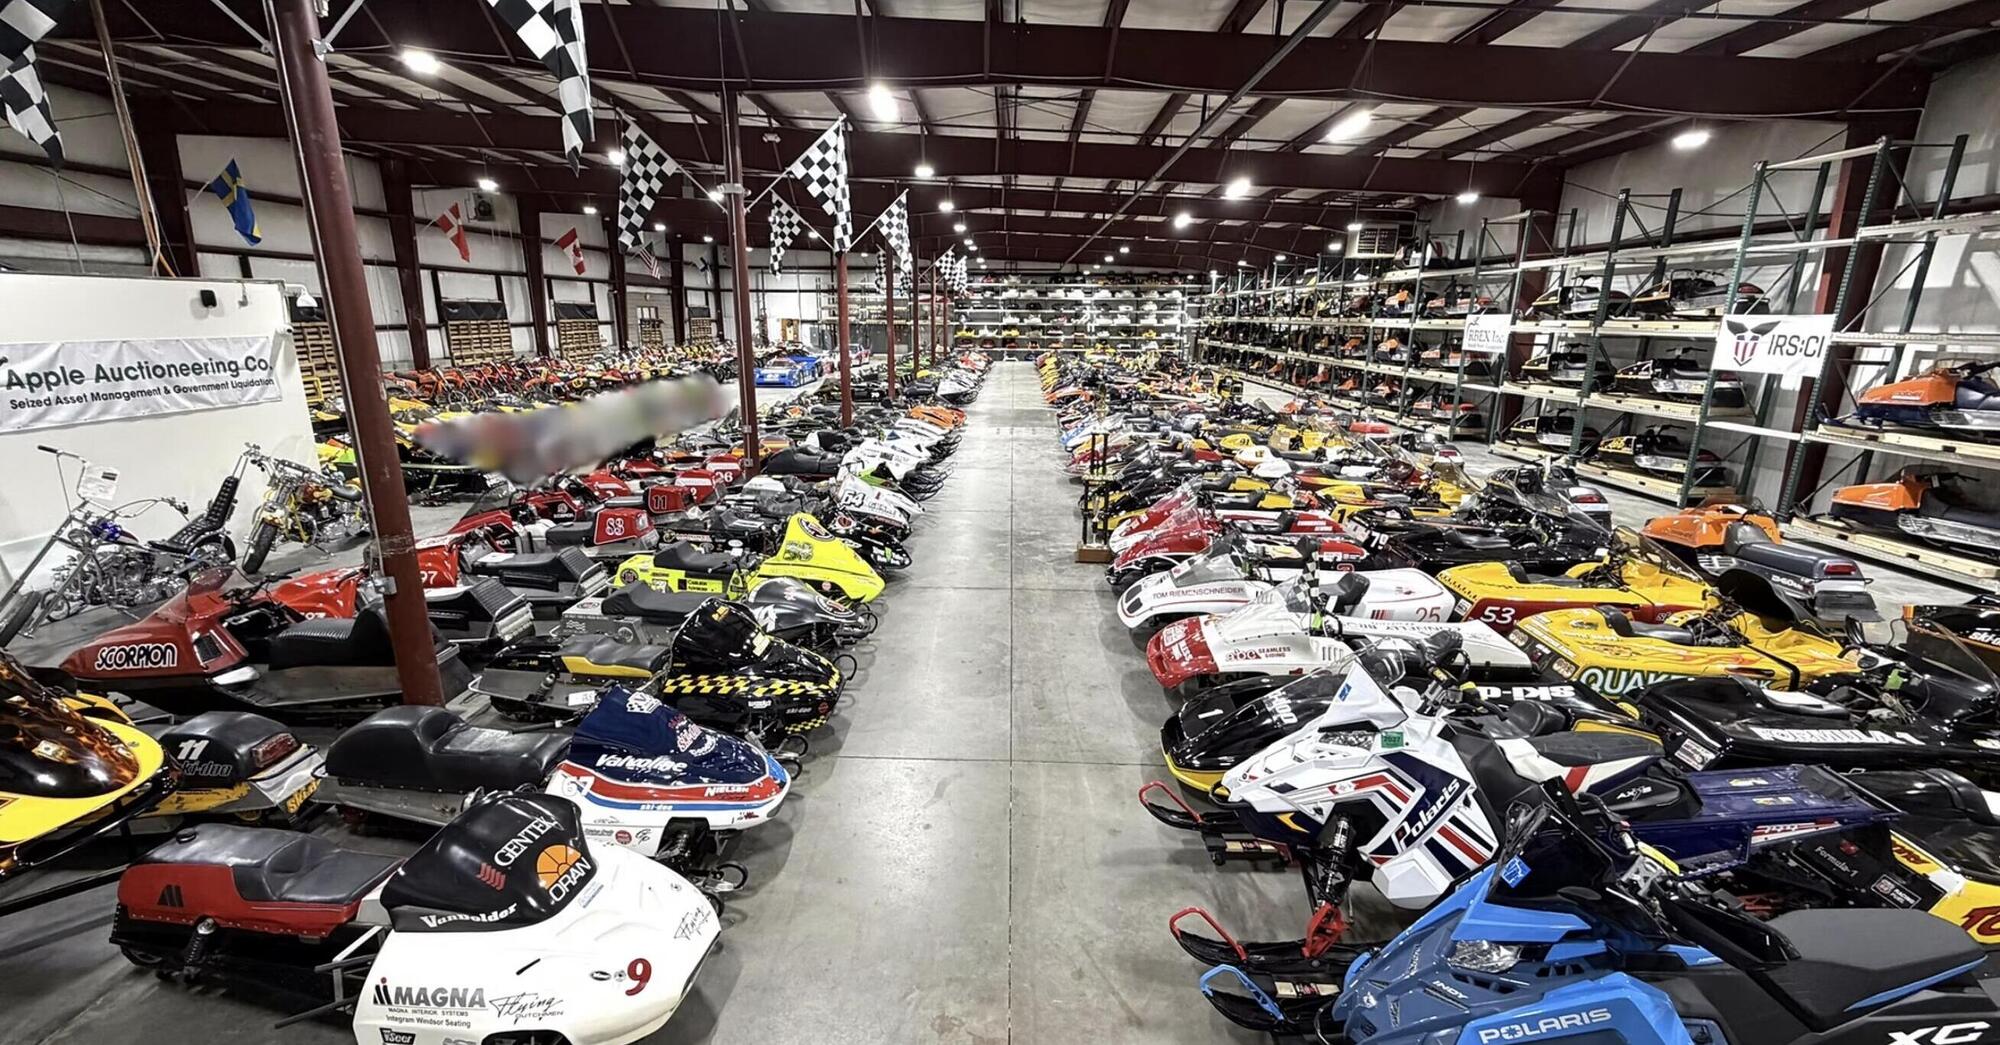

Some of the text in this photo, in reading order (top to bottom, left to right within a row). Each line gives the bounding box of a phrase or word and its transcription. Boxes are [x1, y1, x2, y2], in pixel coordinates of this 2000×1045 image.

[6, 355, 273, 393] Apple Auctioneering Co.
[10, 378, 275, 409] Seized Asset Management & Government Liquidation
[1480, 606, 1516, 624] 53
[95, 643, 177, 670] SCORPION
[1750, 727, 1906, 744] FORMULA
[177, 739, 209, 760] 11
[1391, 778, 1462, 854] Polaris
[625, 957, 652, 996] 9
[394, 986, 487, 1008] MAGNA
[1433, 980, 1469, 999] INDY
[445, 1019, 471, 1029] Seating
[1478, 1007, 1612, 1045] POLARIS
[1887, 1021, 1991, 1045] XC
